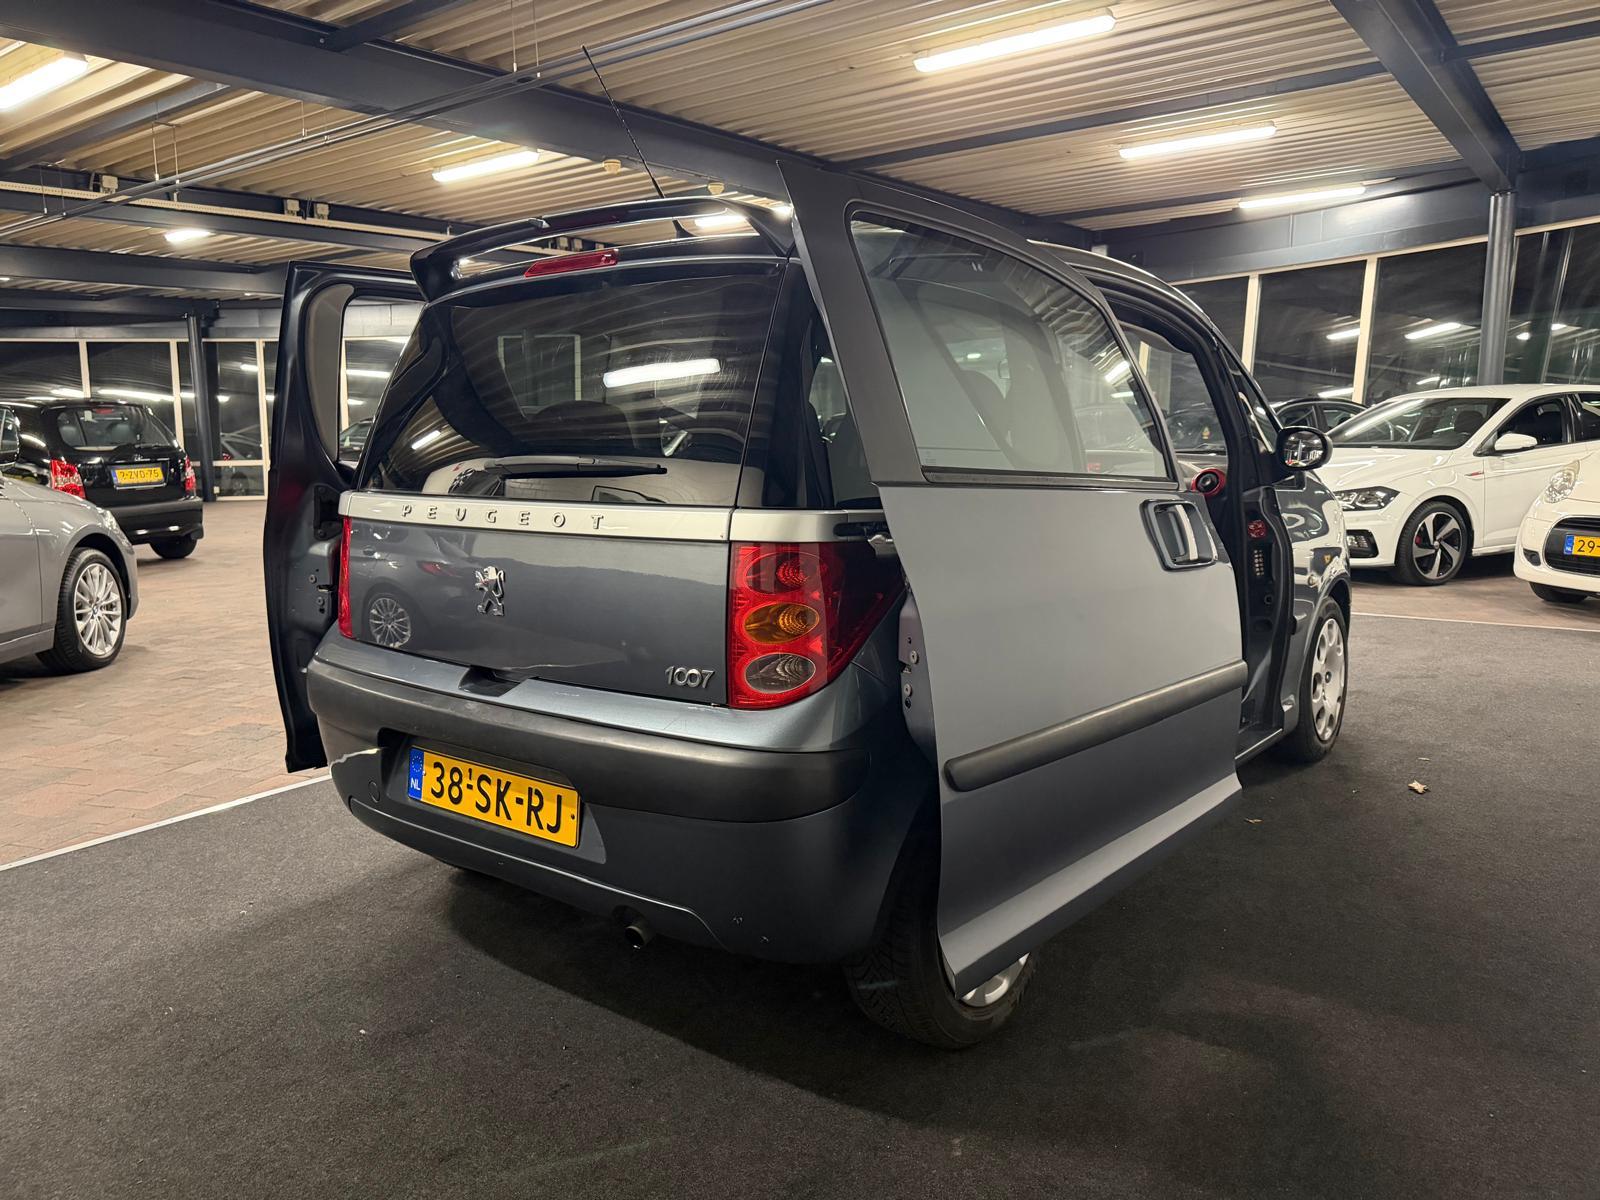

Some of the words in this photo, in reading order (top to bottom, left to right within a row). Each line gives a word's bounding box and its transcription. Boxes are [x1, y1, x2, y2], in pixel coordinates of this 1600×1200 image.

[401, 504, 604, 530] PEUGEOT
[664, 666, 715, 688] 1007
[410, 777, 421, 791] NL
[431, 761, 562, 834] 38-SK-RJ
